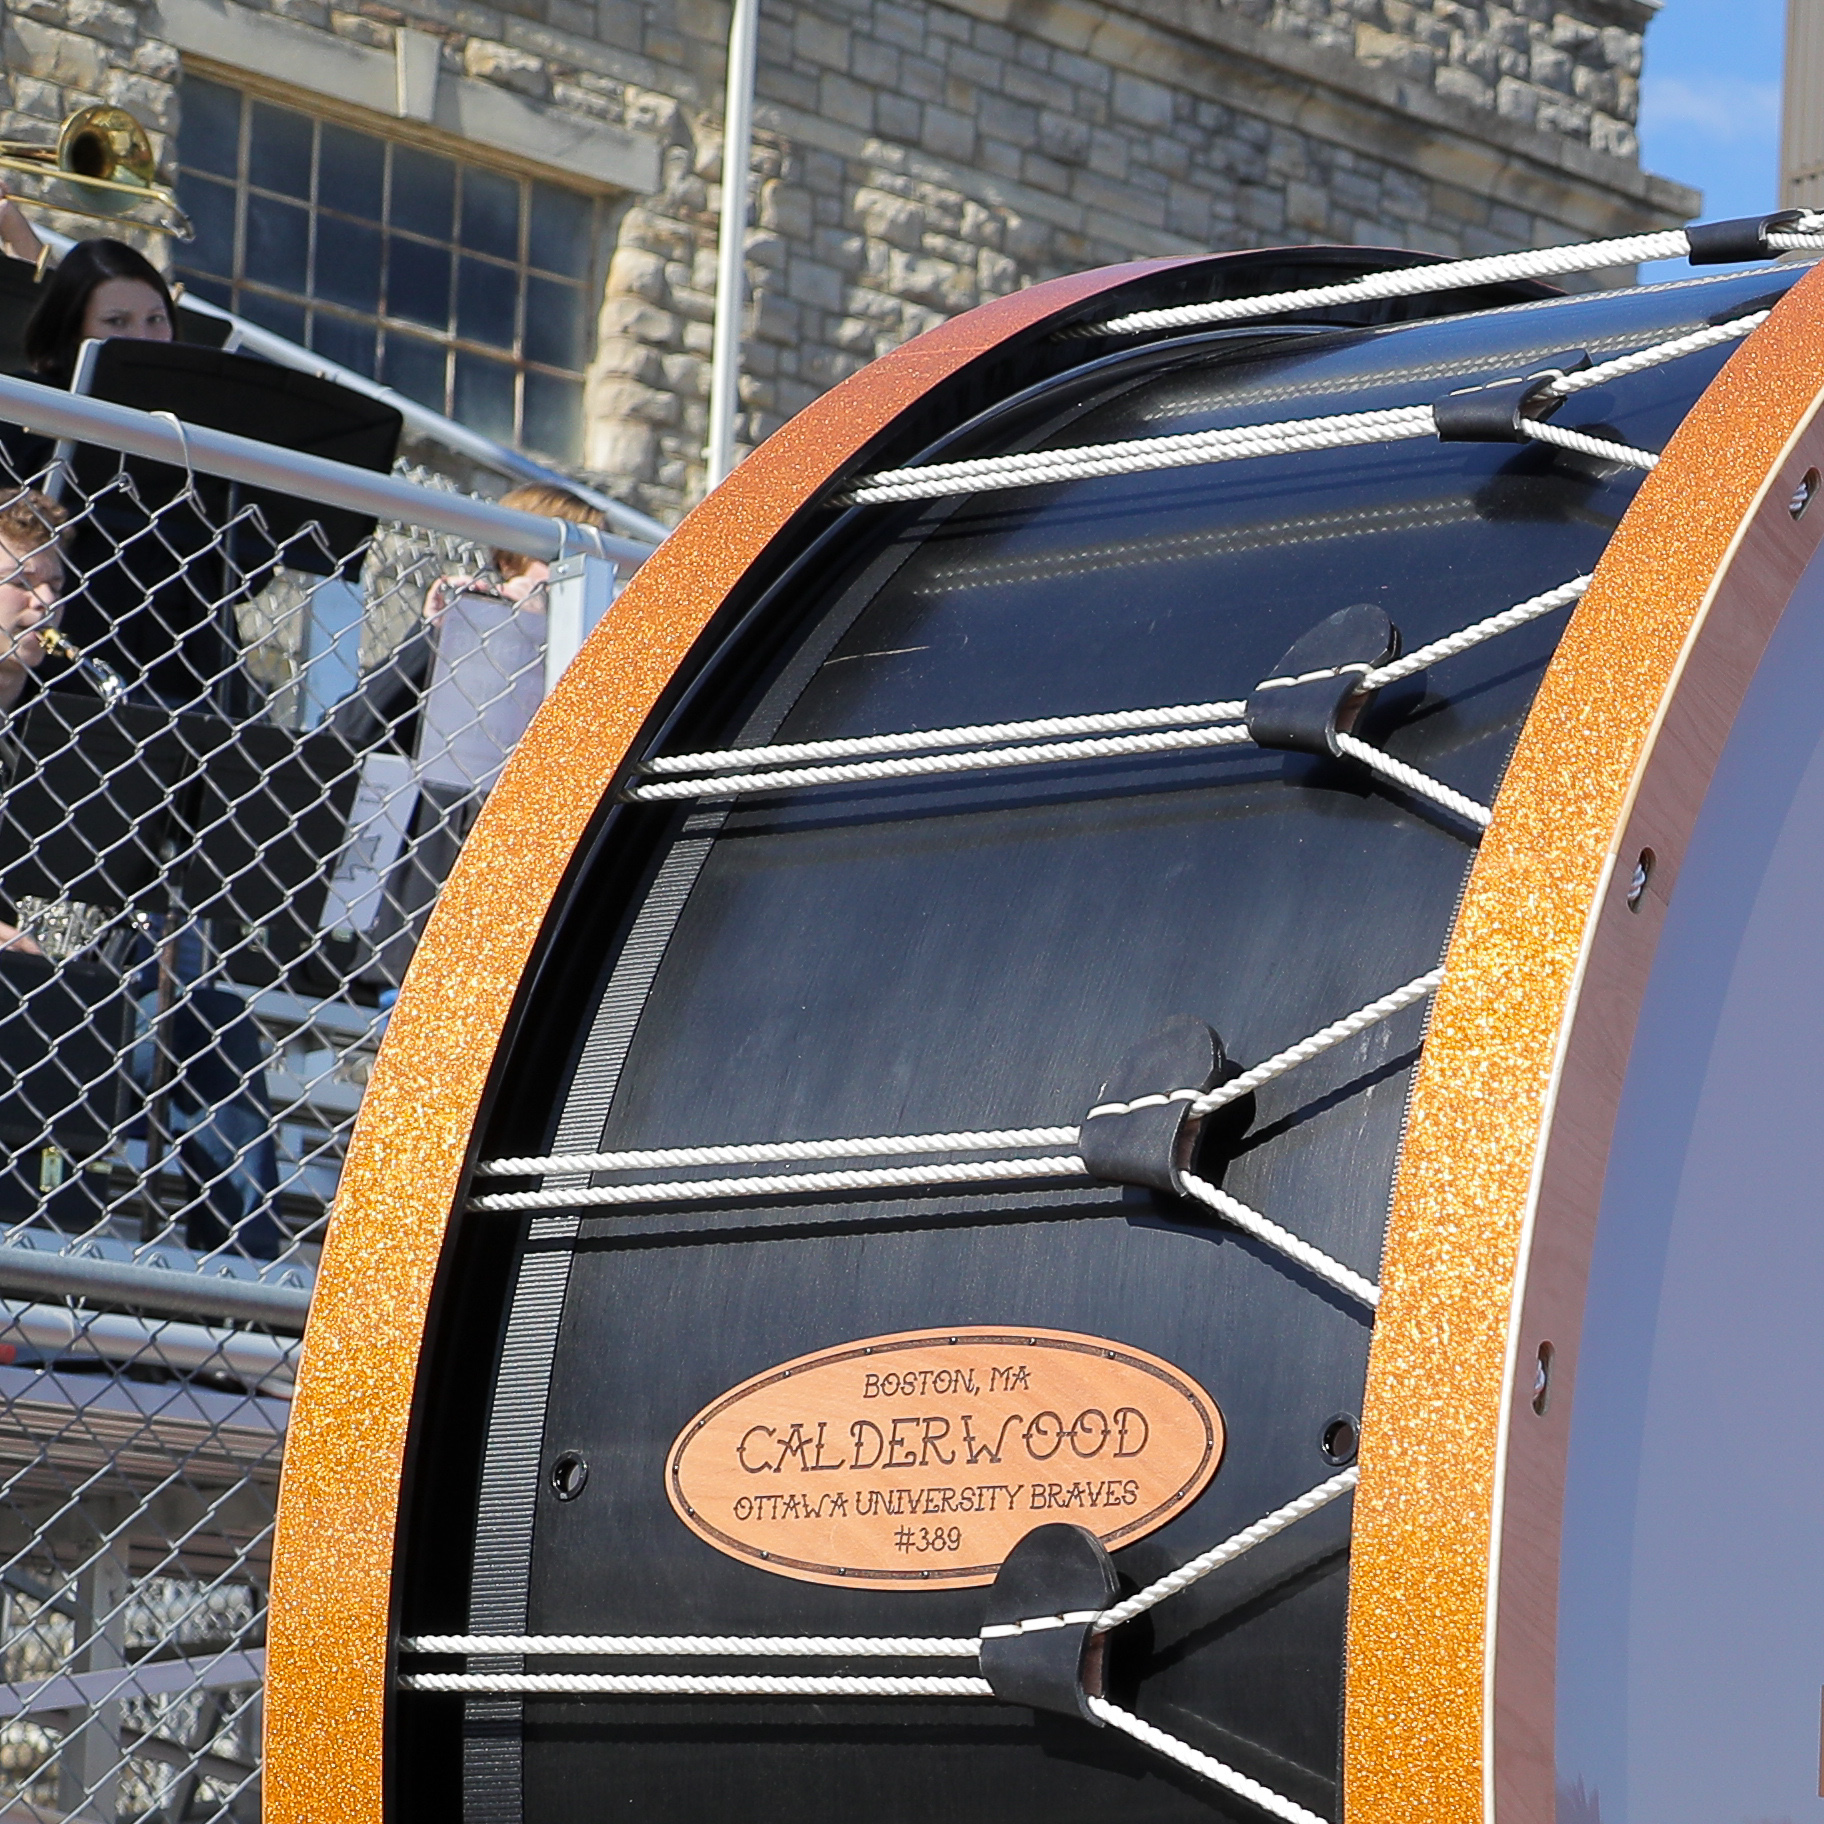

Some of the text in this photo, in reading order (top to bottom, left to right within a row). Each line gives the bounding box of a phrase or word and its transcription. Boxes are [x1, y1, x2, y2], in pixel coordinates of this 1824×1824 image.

[863, 1366, 1030, 1399] BOSTON, MA
[736, 1407, 1150, 1474] CALDERWOOD
[733, 1480, 1139, 1521] OTTAWA UNIVERSITY BRAVES
[894, 1525, 963, 1554] #389
